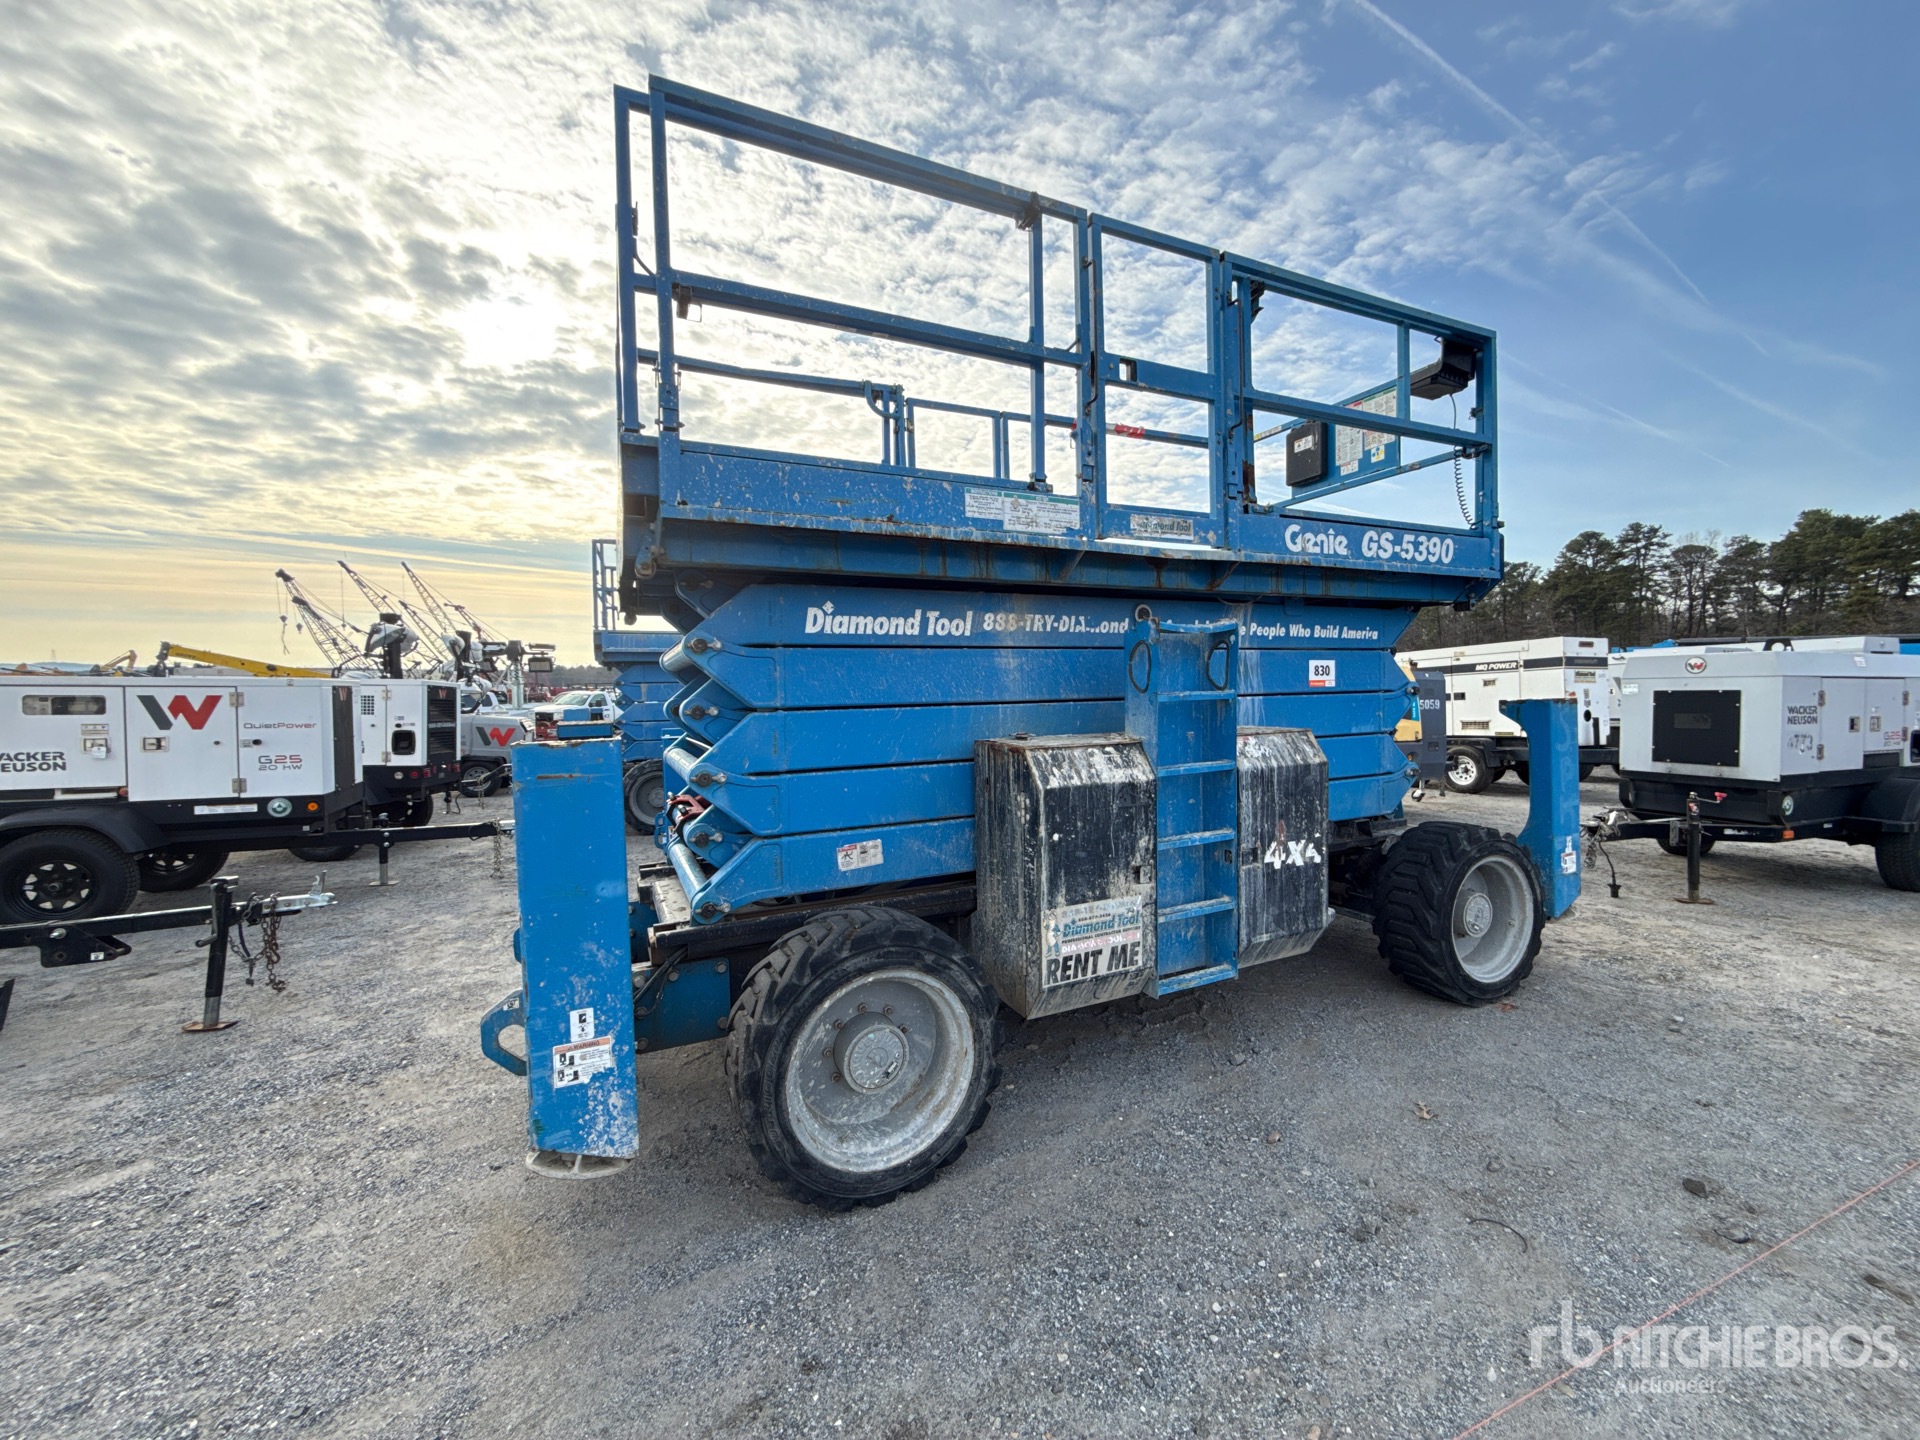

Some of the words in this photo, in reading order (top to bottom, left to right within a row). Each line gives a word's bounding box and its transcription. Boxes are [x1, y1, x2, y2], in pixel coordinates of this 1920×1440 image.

[1285, 524, 1348, 555] Genie
[1361, 530, 1454, 564] GS-5390
[804, 600, 921, 635] Diamond
[926, 610, 973, 637] Tool
[1249, 623, 1286, 640] People
[1289, 624, 1311, 638] Who
[1314, 625, 1339, 639] Build
[1341, 626, 1378, 640] America
[1314, 665, 1331, 676] 830
[1488, 662, 1518, 670] POWER
[1787, 706, 1818, 715] WACKER
[1787, 715, 1818, 725] NEUSON
[0, 751, 66, 762] ACKER
[258, 754, 303, 764] G25
[0, 761, 67, 773] EUSON
[1063, 914, 1116, 938] Diamond
[1117, 909, 1140, 927] Tool
[1061, 935, 1094, 944] PROFESSIONAL
[1094, 930, 1121, 938] CONTRACTOR
[1043, 948, 1103, 986] RENT
[1106, 940, 1141, 972] ME
